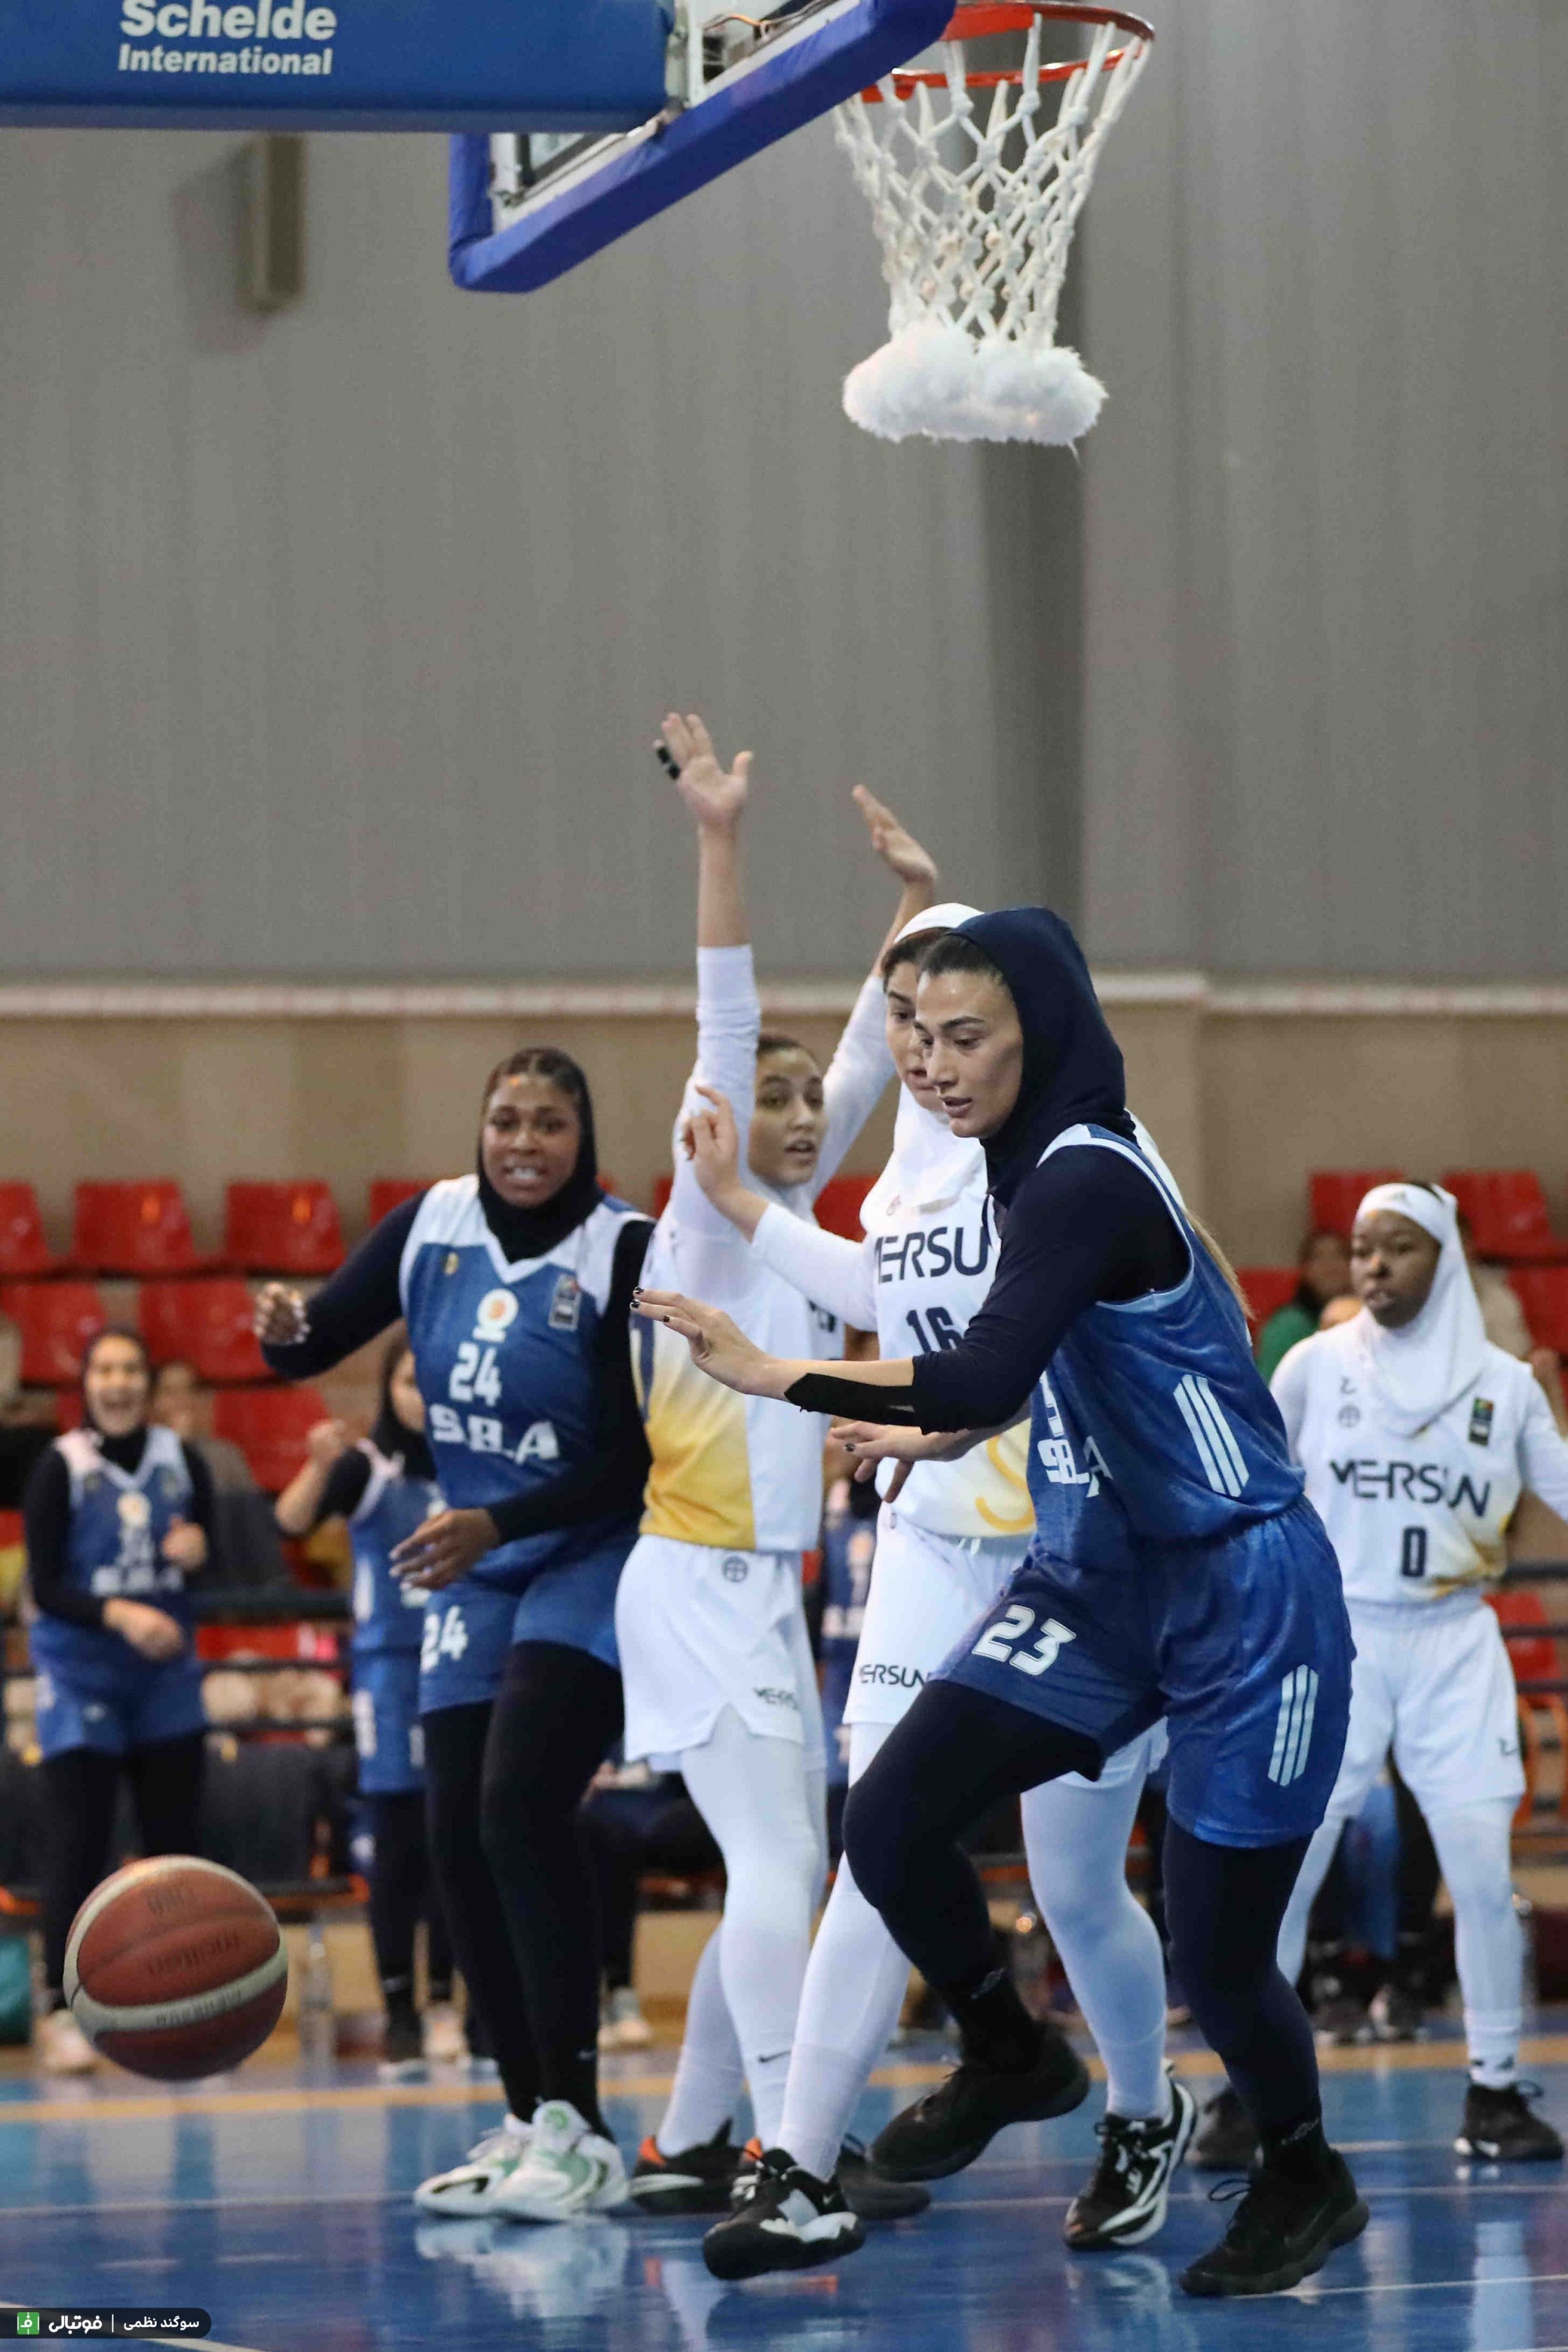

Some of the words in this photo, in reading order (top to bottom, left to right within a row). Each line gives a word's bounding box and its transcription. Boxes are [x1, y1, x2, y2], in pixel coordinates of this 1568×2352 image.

[120, 0, 337, 41] Schelde
[118, 43, 333, 76] International
[449, 1342, 502, 1407] 24
[1401, 1527, 1427, 1577] 0
[420, 1605, 468, 1674] 24
[972, 1604, 1077, 1676] 23
[859, 1664, 930, 1687] ERSUN
